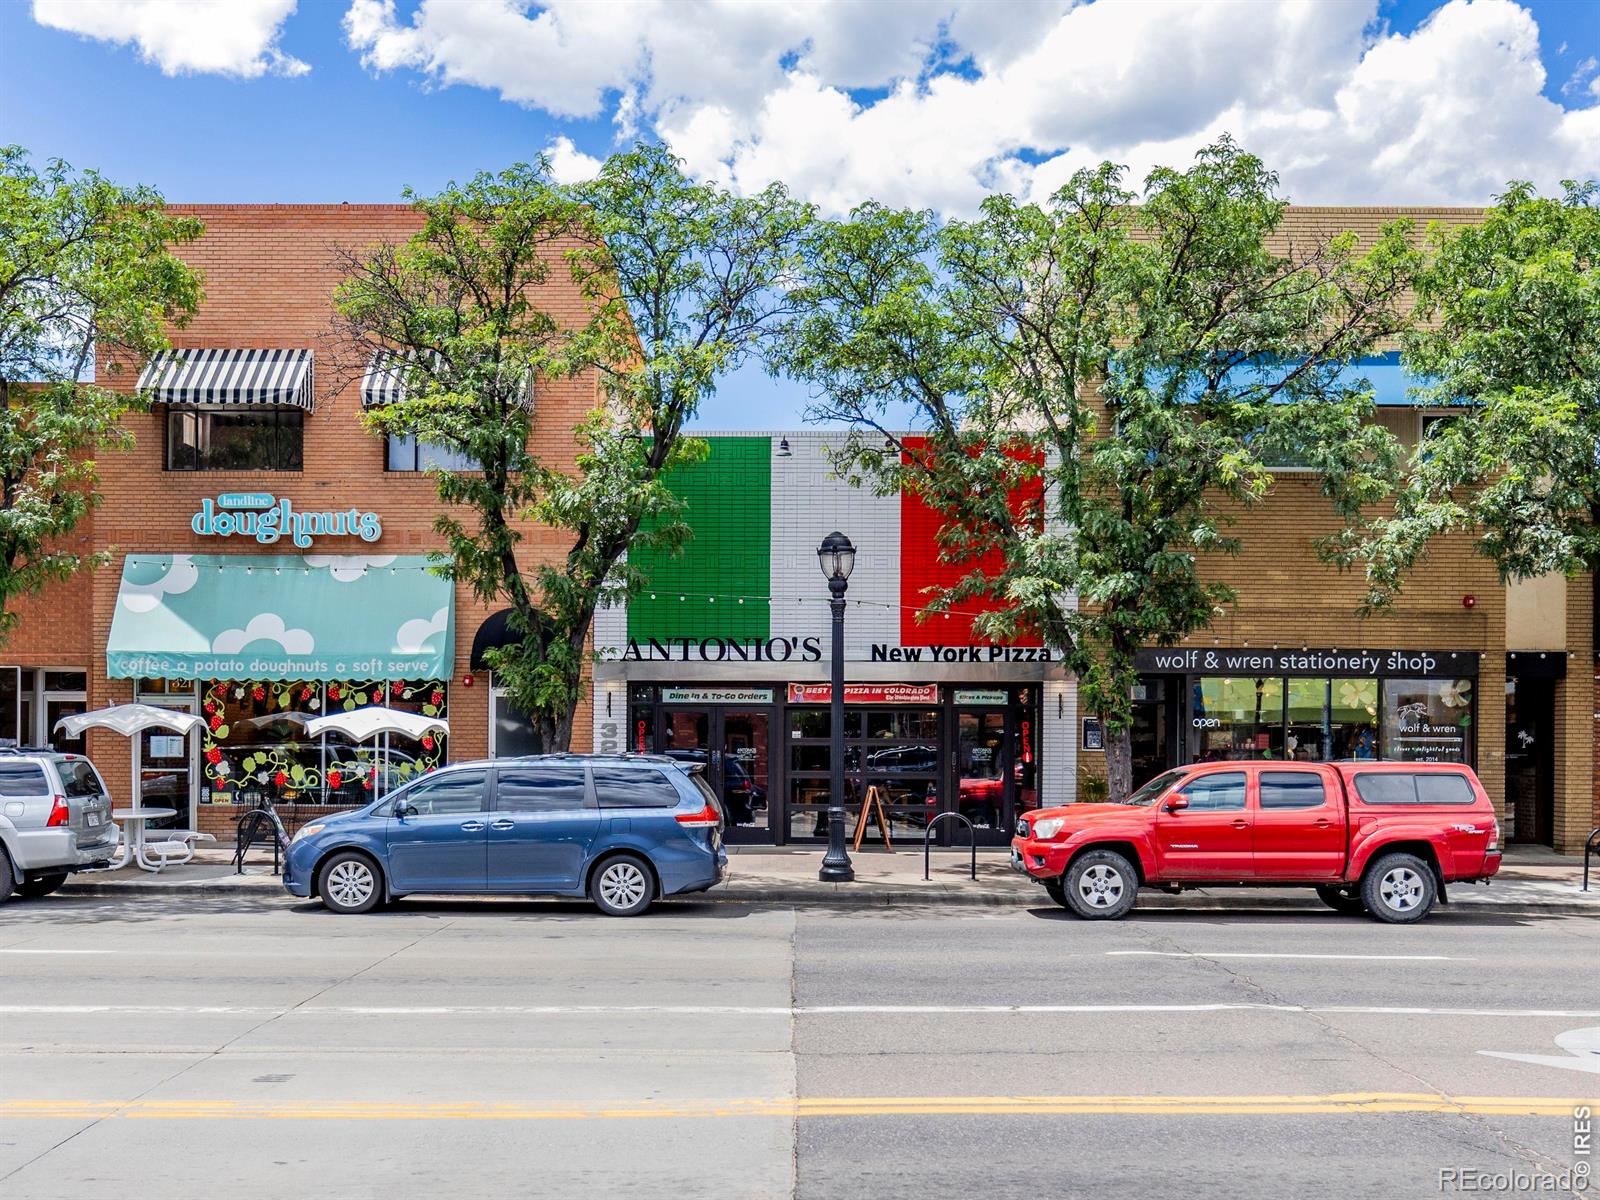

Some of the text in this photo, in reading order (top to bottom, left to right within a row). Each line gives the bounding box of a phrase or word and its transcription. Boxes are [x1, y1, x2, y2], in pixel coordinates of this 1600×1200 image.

[223, 495, 268, 506] landline
[192, 498, 382, 548] doughnuts
[620, 636, 822, 662] ANTONIO'S
[871, 643, 1051, 663] New York Pizza
[120, 656, 429, 675] coffee potato doughnuts soft serve
[1155, 650, 1436, 675] wolf & wren stationery shop
[669, 692, 690, 700] Dine
[701, 692, 709, 700] &
[711, 692, 736, 700] To-Go
[737, 692, 768, 700] Orders
[844, 687, 869, 695] PIZZA
[883, 687, 930, 695] COLORADO
[1192, 718, 1220, 729] open
[1400, 723, 1421, 733] wolf
[1422, 723, 1431, 733] &
